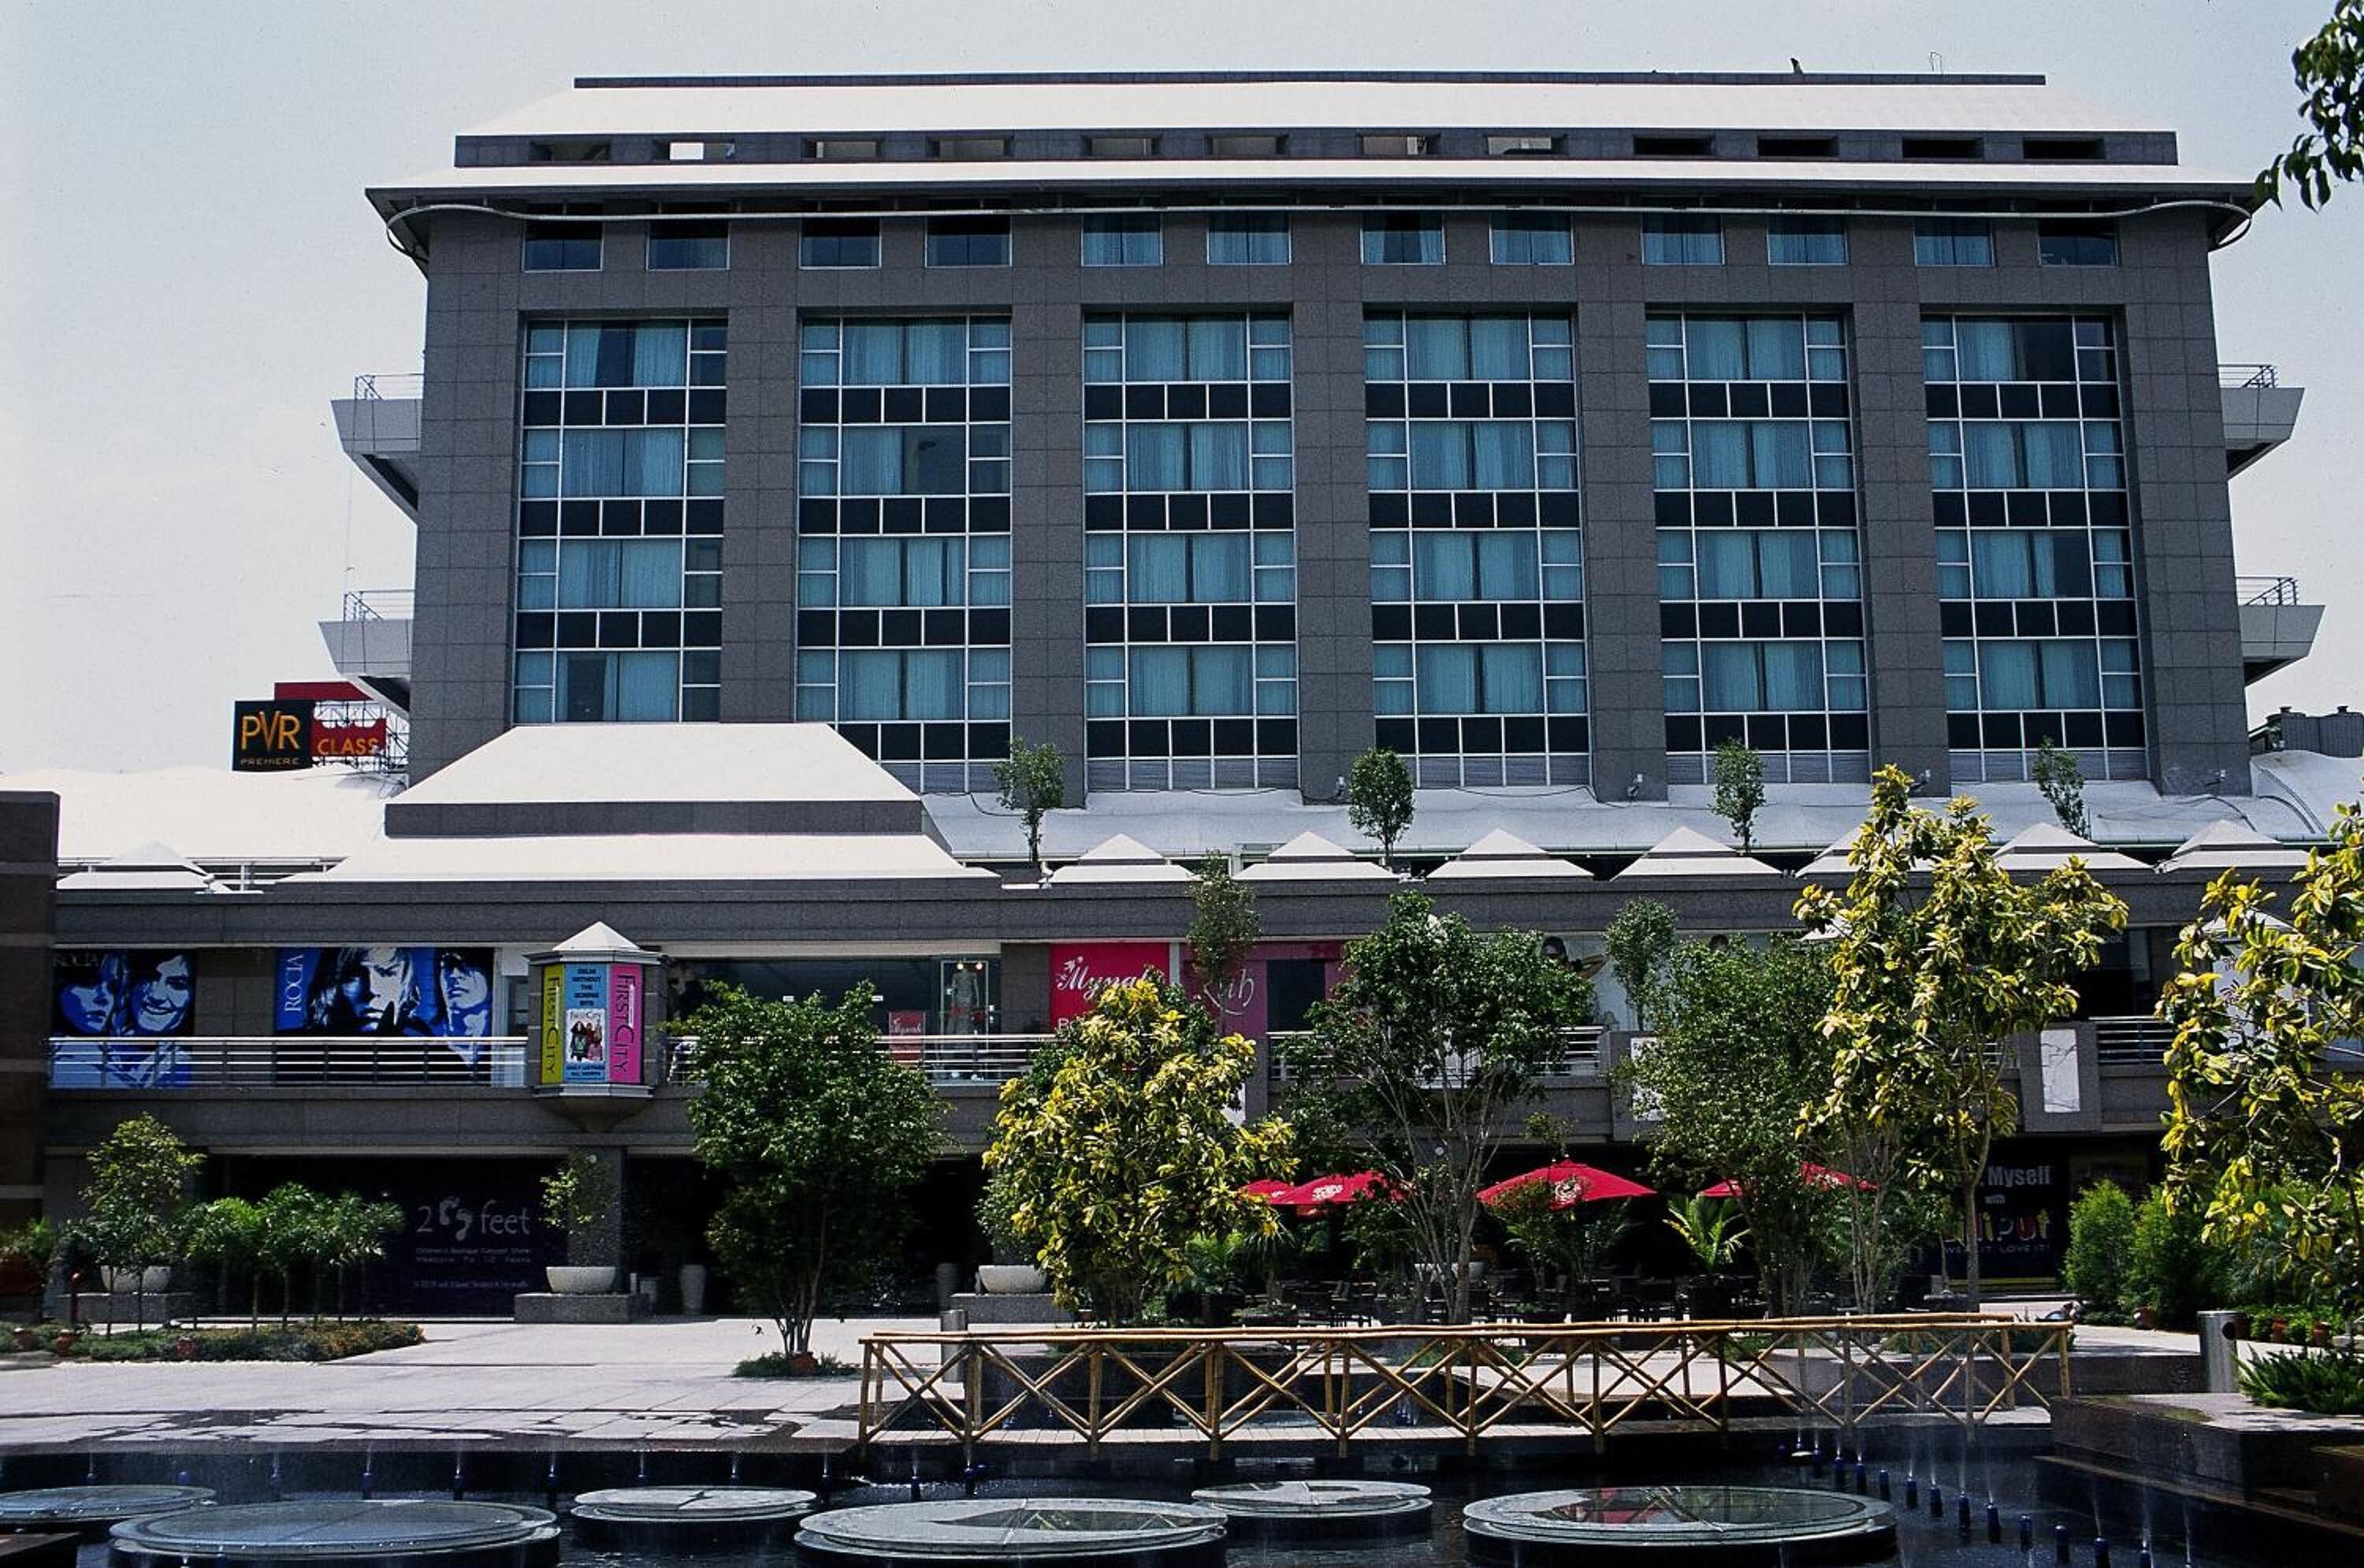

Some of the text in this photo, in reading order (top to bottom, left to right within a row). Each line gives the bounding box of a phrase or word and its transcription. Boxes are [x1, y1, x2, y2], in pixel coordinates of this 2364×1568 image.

[241, 709, 301, 752] PVR
[240, 756, 299, 765] PREMIERE
[317, 738, 379, 756] CLASS
[415, 1199, 530, 1235] 2 feet
